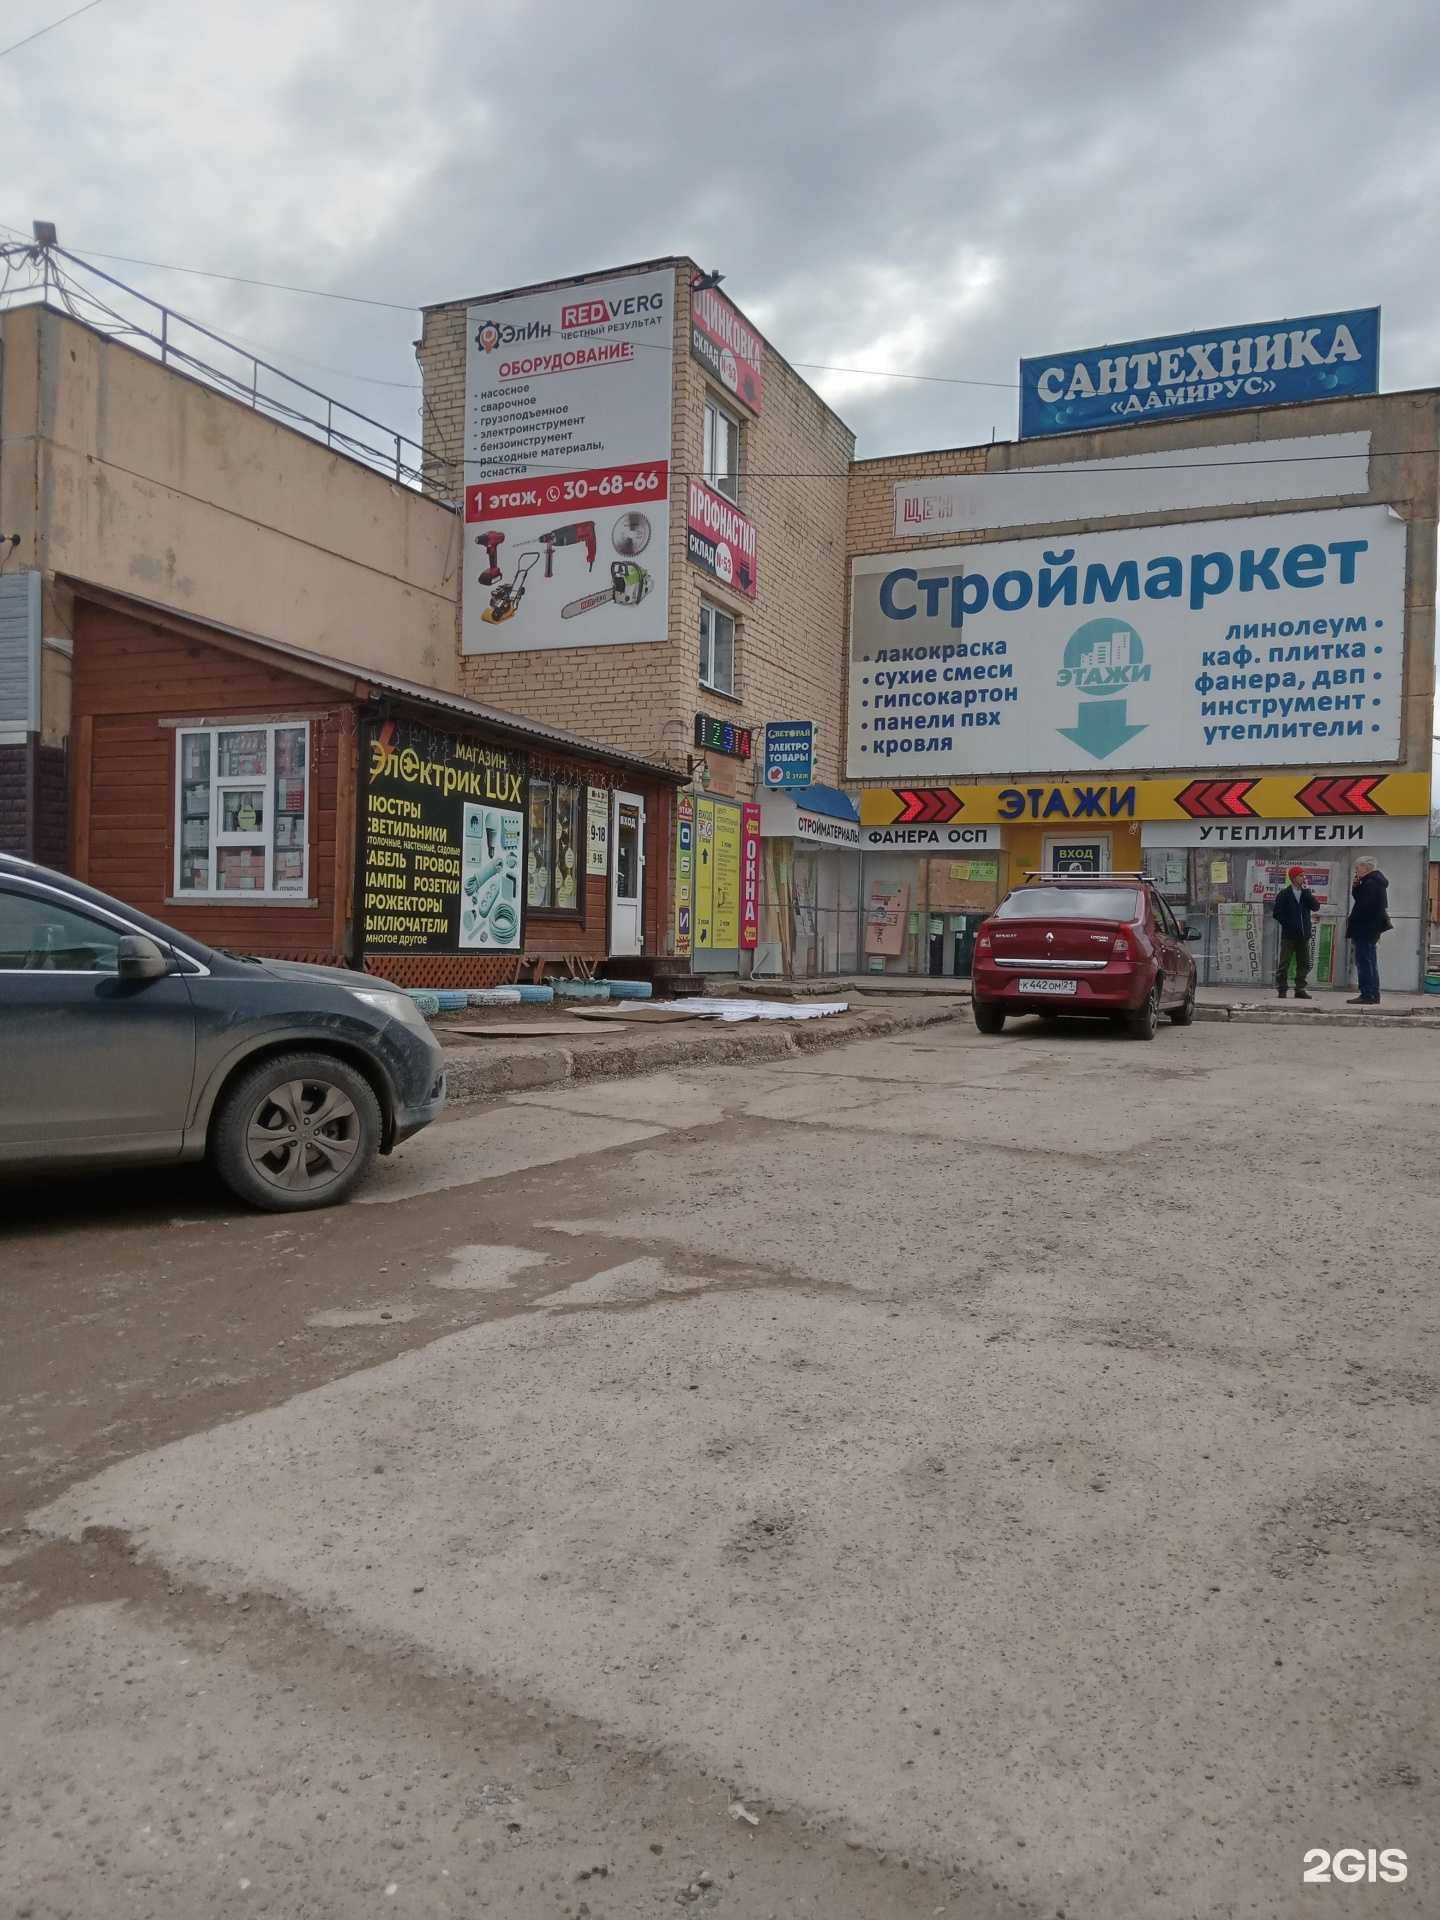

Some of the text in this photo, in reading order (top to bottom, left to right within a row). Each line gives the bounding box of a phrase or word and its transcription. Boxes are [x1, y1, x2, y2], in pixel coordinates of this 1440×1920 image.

[560, 316, 664, 341] ЧЕСТНЫЙ РЕЗУЛЬТАТ
[499, 342, 635, 378] ОБОРУДОВАНИЕ:
[693, 329, 720, 370] СКЛАД
[1036, 324, 1363, 404] САНТЕХНИКА
[480, 384, 531, 400] насосное
[1110, 376, 1277, 417] «ДАМИРУС»
[480, 396, 537, 414] сварочное
[480, 404, 570, 427] грузоподъемное
[480, 415, 587, 440] электроинструмент
[480, 431, 574, 452] бензоинструмент
[480, 441, 605, 467] расходные материалы,
[480, 466, 528, 479] оснастка
[473, 470, 660, 513] 1 этаж, 30-68-66
[689, 483, 757, 558] ПРОФНАСТИЛ
[689, 534, 715, 567] СКЛАД
[879, 539, 1369, 629] Строймаркет
[1225, 616, 1368, 641] линолеум
[874, 640, 1007, 664] лакокраска
[1202, 641, 1367, 669] каф. плитка
[874, 663, 1014, 690] сухие смеси
[1055, 663, 1153, 688] ЭТАЖИ
[1194, 668, 1366, 696] фанера, двп
[873, 686, 1019, 709] гипсокартон
[1201, 693, 1366, 719] инструмент
[873, 710, 1002, 732] панели пвх
[1202, 719, 1364, 746] утеплители
[455, 743, 507, 770] МАГАЗИН
[768, 742, 810, 752] ЭЛЕКТРО
[769, 753, 809, 763] ТОВАРЫ
[872, 736, 954, 758] кровля
[486, 768, 522, 805] LUX
[996, 785, 1137, 820] ЭТАЖИ
[367, 818, 448, 844] ВЕТИЛЬНИКИ
[590, 825, 606, 843] 9-18
[798, 816, 860, 844] СТРОЙМАТЕРИАЛЫ
[867, 829, 988, 845] ФАНЕРА ОСП
[1199, 824, 1365, 841] УТЕПЛИТЕЛИ
[414, 855, 461, 878] ПРОВОД
[1059, 849, 1094, 860] ВХОД
[413, 876, 461, 895] РОЗЕТКИ
[745, 839, 757, 921] ОКНА
[365, 933, 428, 947] многое другое
